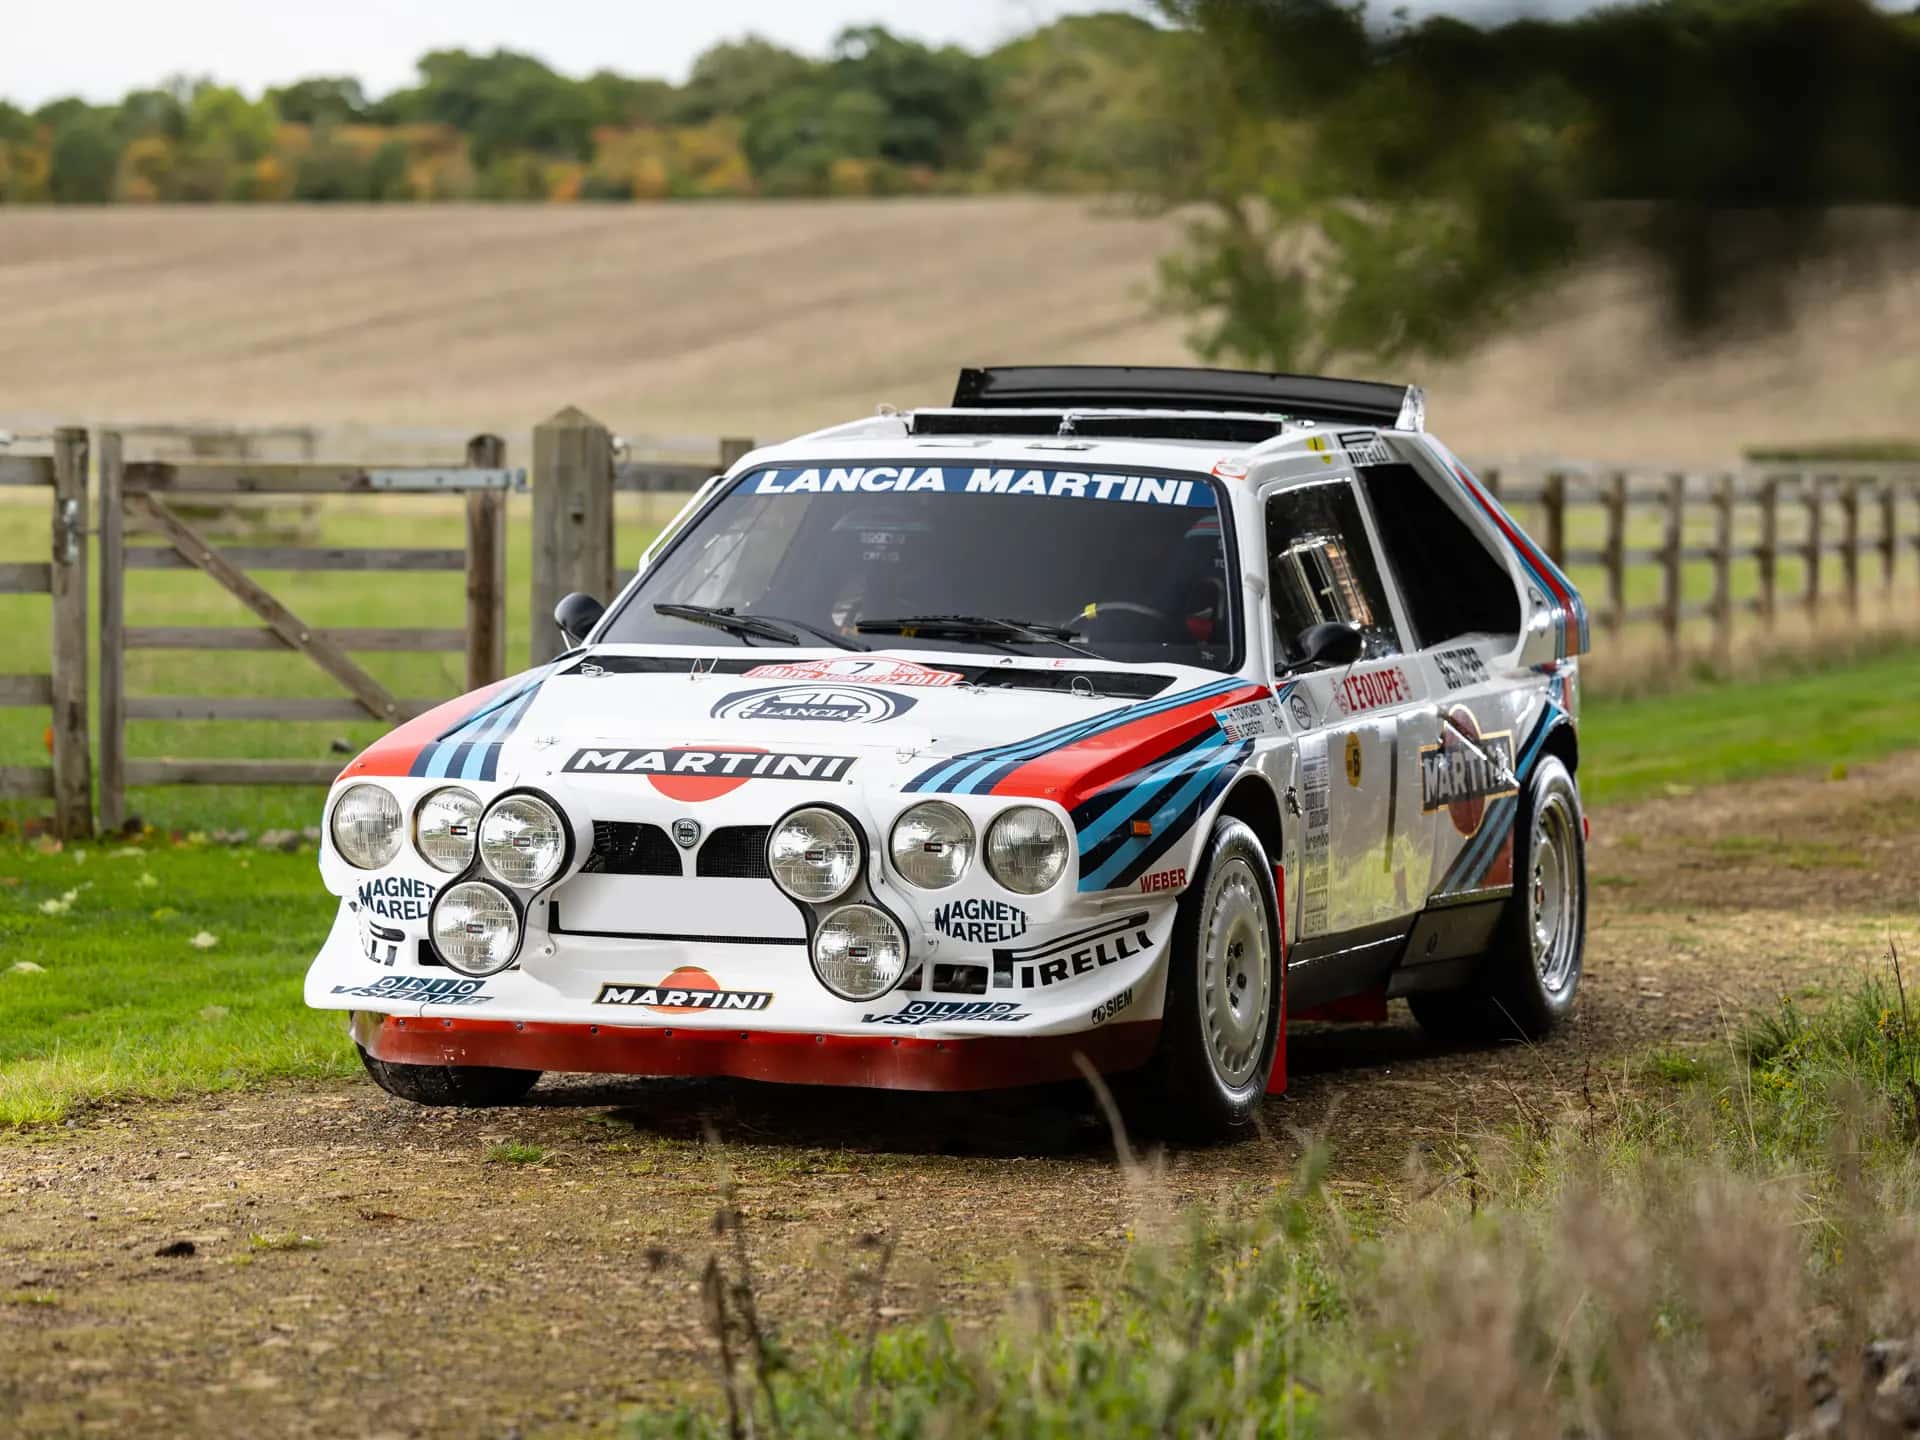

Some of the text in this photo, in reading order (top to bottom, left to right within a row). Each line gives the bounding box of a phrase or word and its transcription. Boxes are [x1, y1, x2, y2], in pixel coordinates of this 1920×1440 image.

[755, 467, 1193, 506] LANCIA MARTINI
[850, 662, 875, 675] 7
[761, 706, 850, 719] LANCIA
[573, 750, 846, 778] MARTINI
[358, 877, 436, 906] MAGNET
[1140, 868, 1188, 893] WEBER
[358, 889, 431, 920] MAREL
[935, 899, 1026, 932] MAGNETI
[935, 908, 1026, 943] MARELLI
[992, 911, 1154, 989] PIRELLI
[373, 976, 483, 995] OLIO
[601, 987, 766, 1010] MARTINI
[902, 1000, 1018, 1015] OLIO
[1106, 988, 1133, 1018] SIEM
